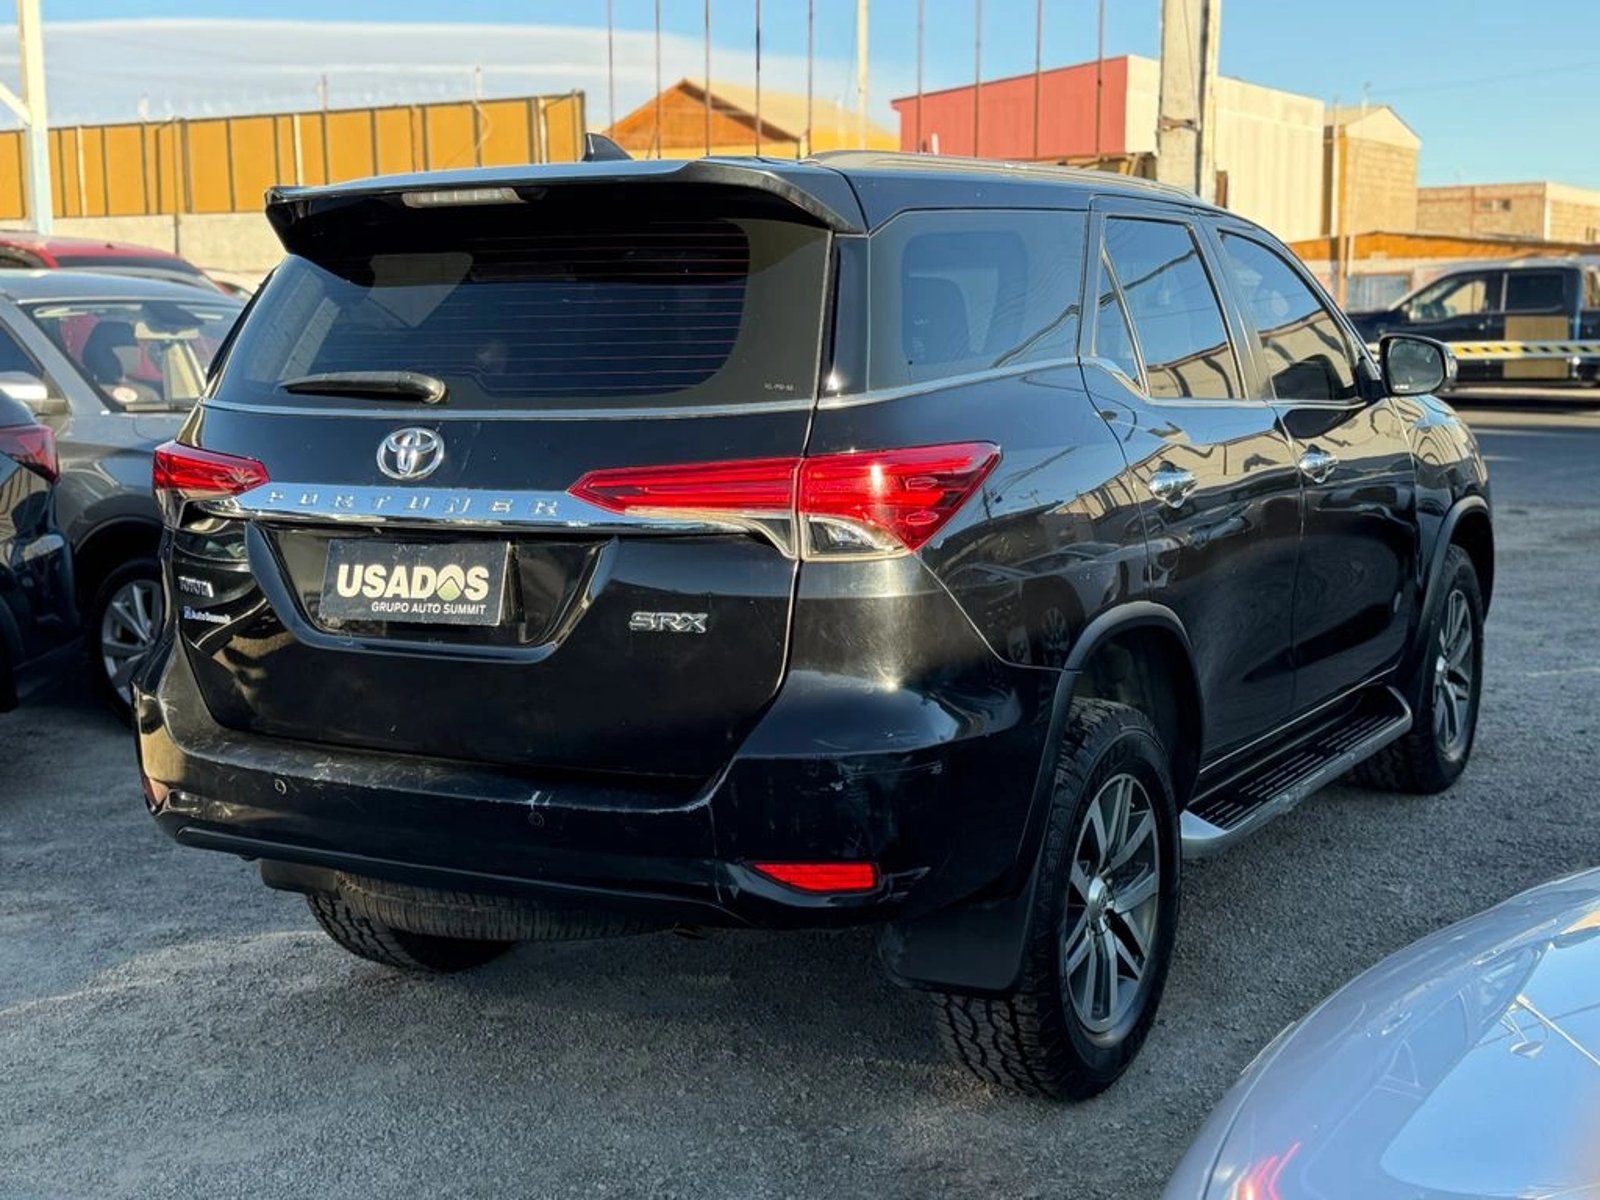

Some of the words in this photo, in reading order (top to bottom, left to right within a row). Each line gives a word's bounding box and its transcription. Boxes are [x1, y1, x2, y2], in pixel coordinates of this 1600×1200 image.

[336, 563, 490, 601] USADOS
[371, 601, 409, 613] GRUPO
[411, 603, 441, 614] AUTO
[443, 603, 487, 615] SUMMIT
[629, 611, 708, 633] SRX
